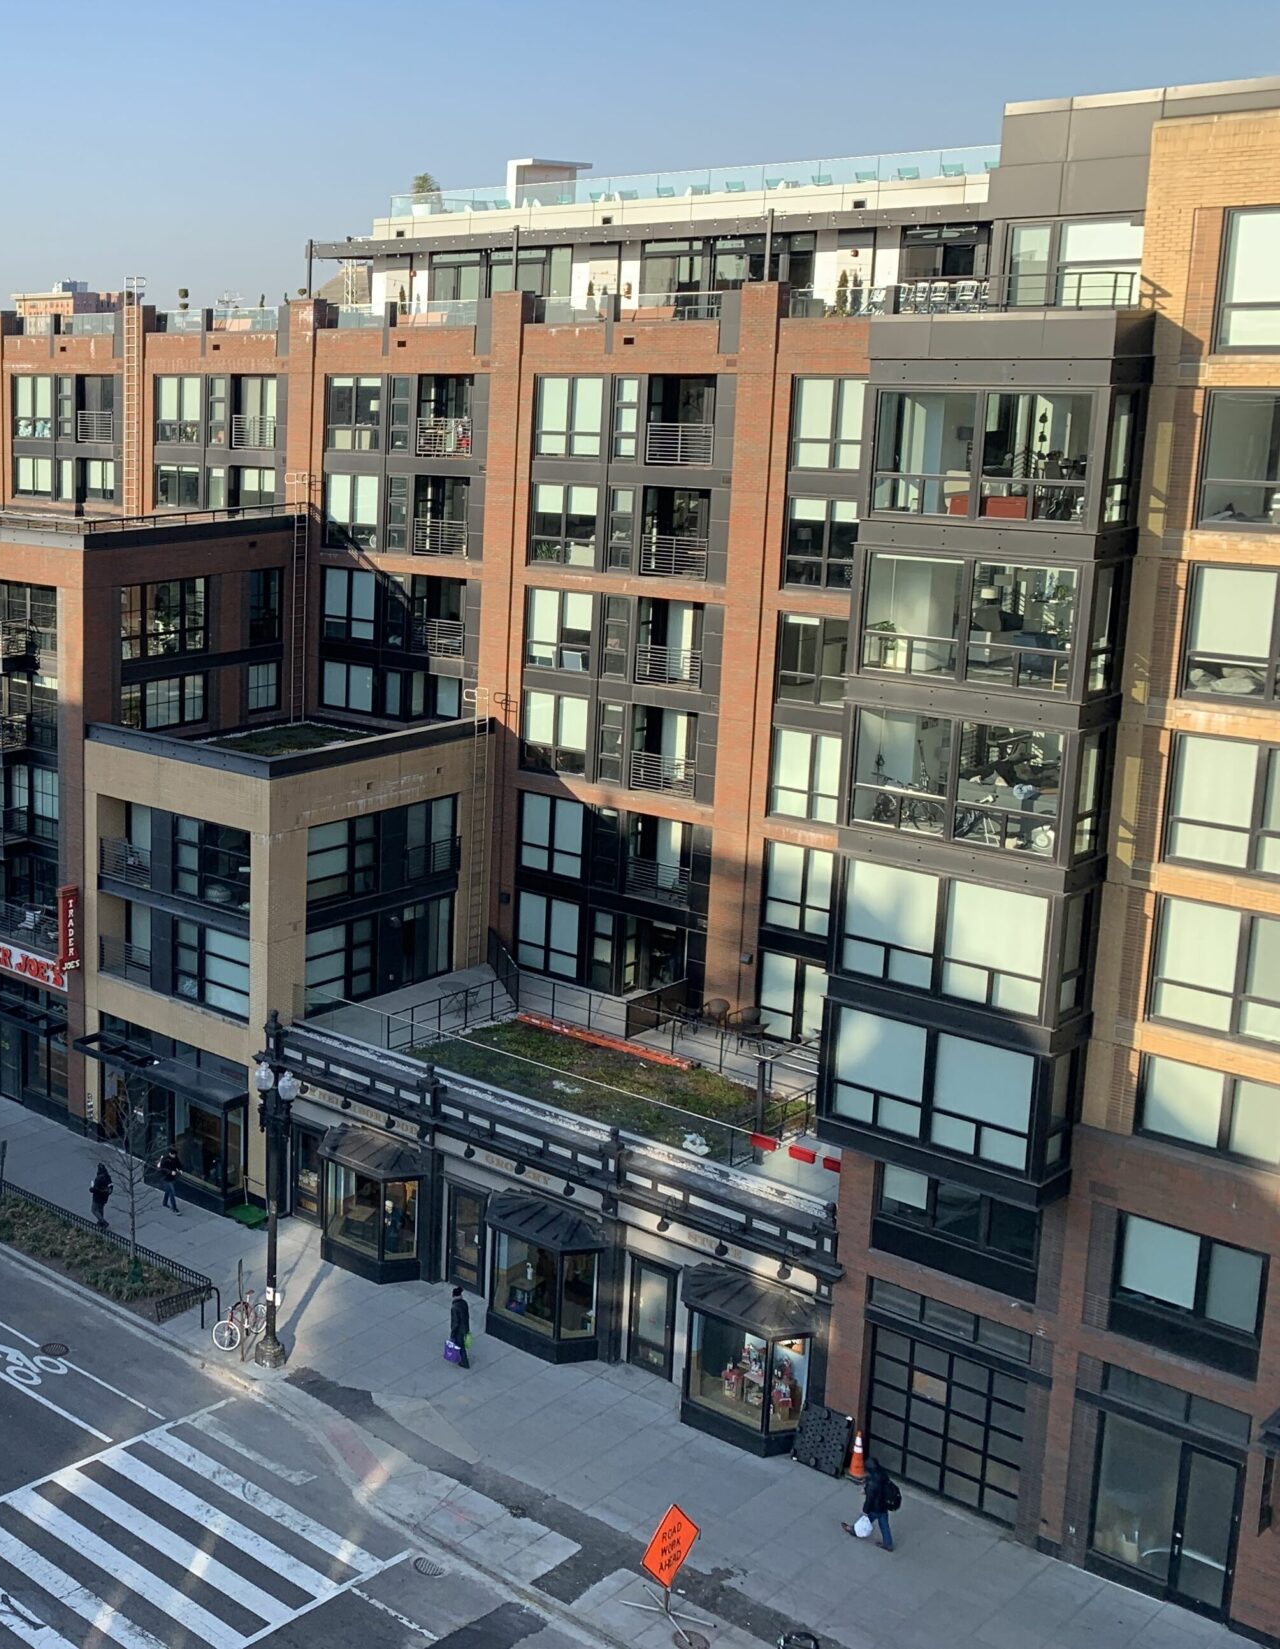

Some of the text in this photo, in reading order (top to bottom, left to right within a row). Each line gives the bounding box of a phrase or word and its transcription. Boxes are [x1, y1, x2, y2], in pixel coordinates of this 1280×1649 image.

[67, 899, 75, 957] TRADER
[16, 953, 64, 987] JOE'S
[661, 1521, 683, 1543] ROAD
[661, 1536, 681, 1557] WORK
[658, 1550, 682, 1574] AHEAD
